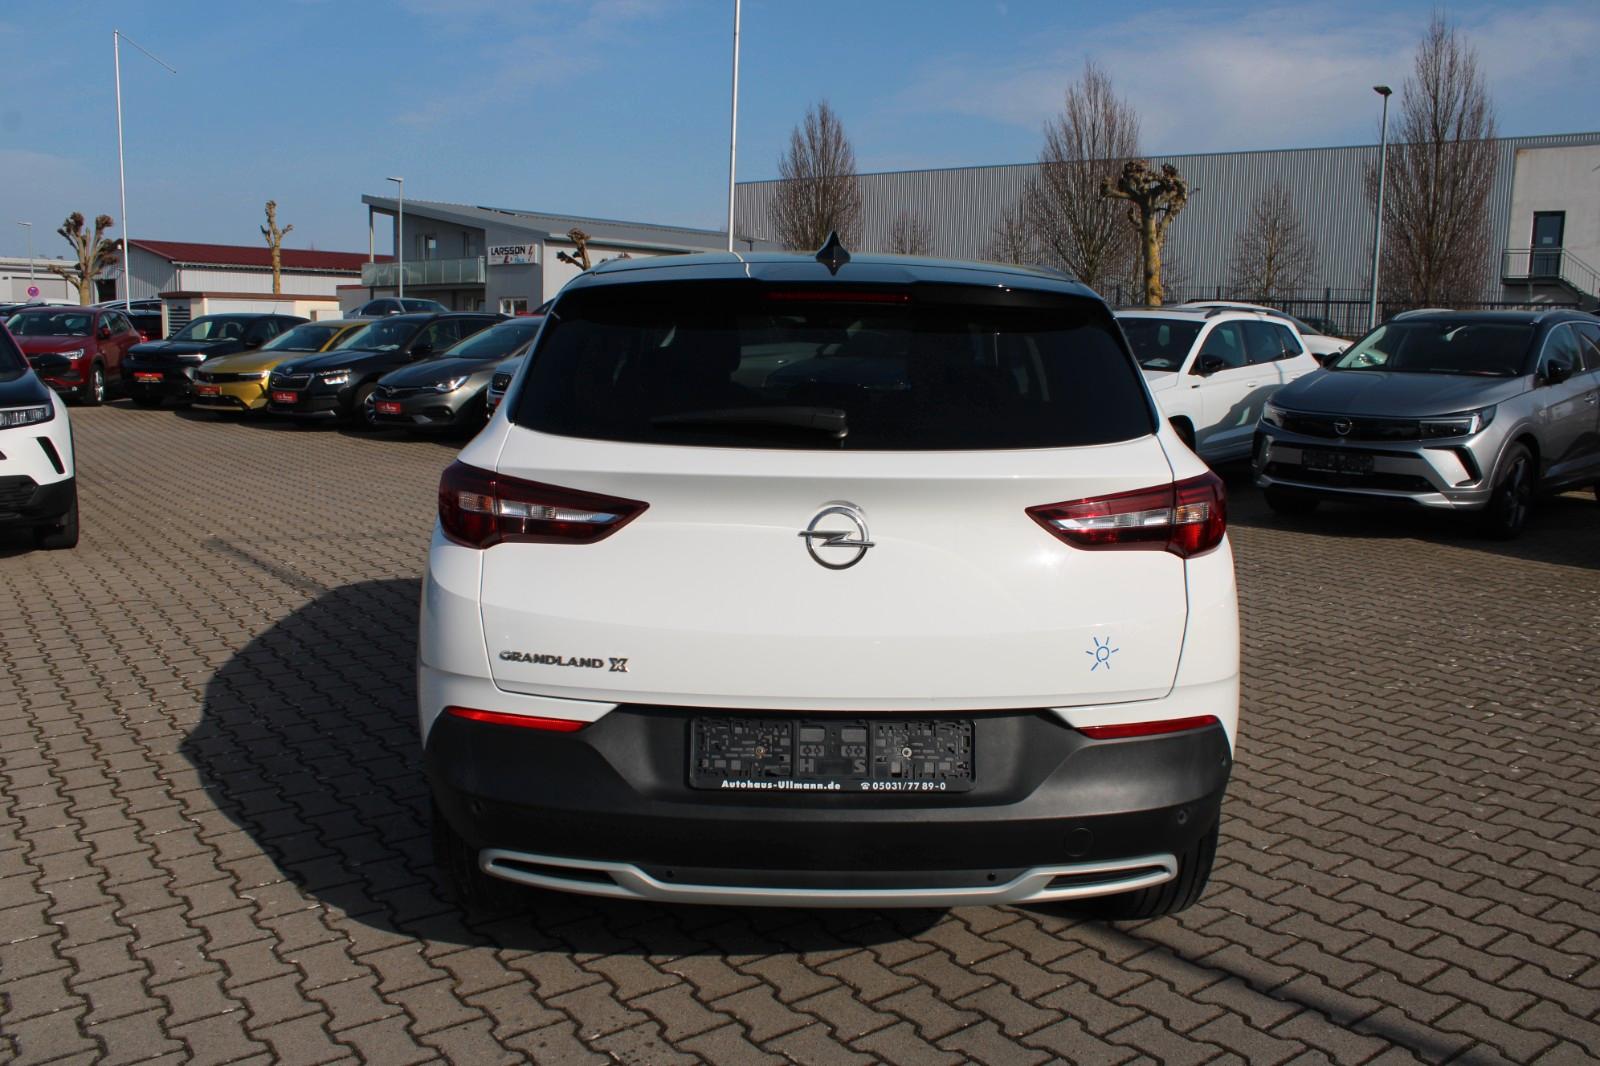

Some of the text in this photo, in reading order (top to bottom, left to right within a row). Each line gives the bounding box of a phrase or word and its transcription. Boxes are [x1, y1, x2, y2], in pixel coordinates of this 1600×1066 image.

[490, 246, 526, 256] LARSSON
[499, 651, 629, 673] GRANDLAND X
[721, 780, 841, 791] Autohaus-Ullmann.de
